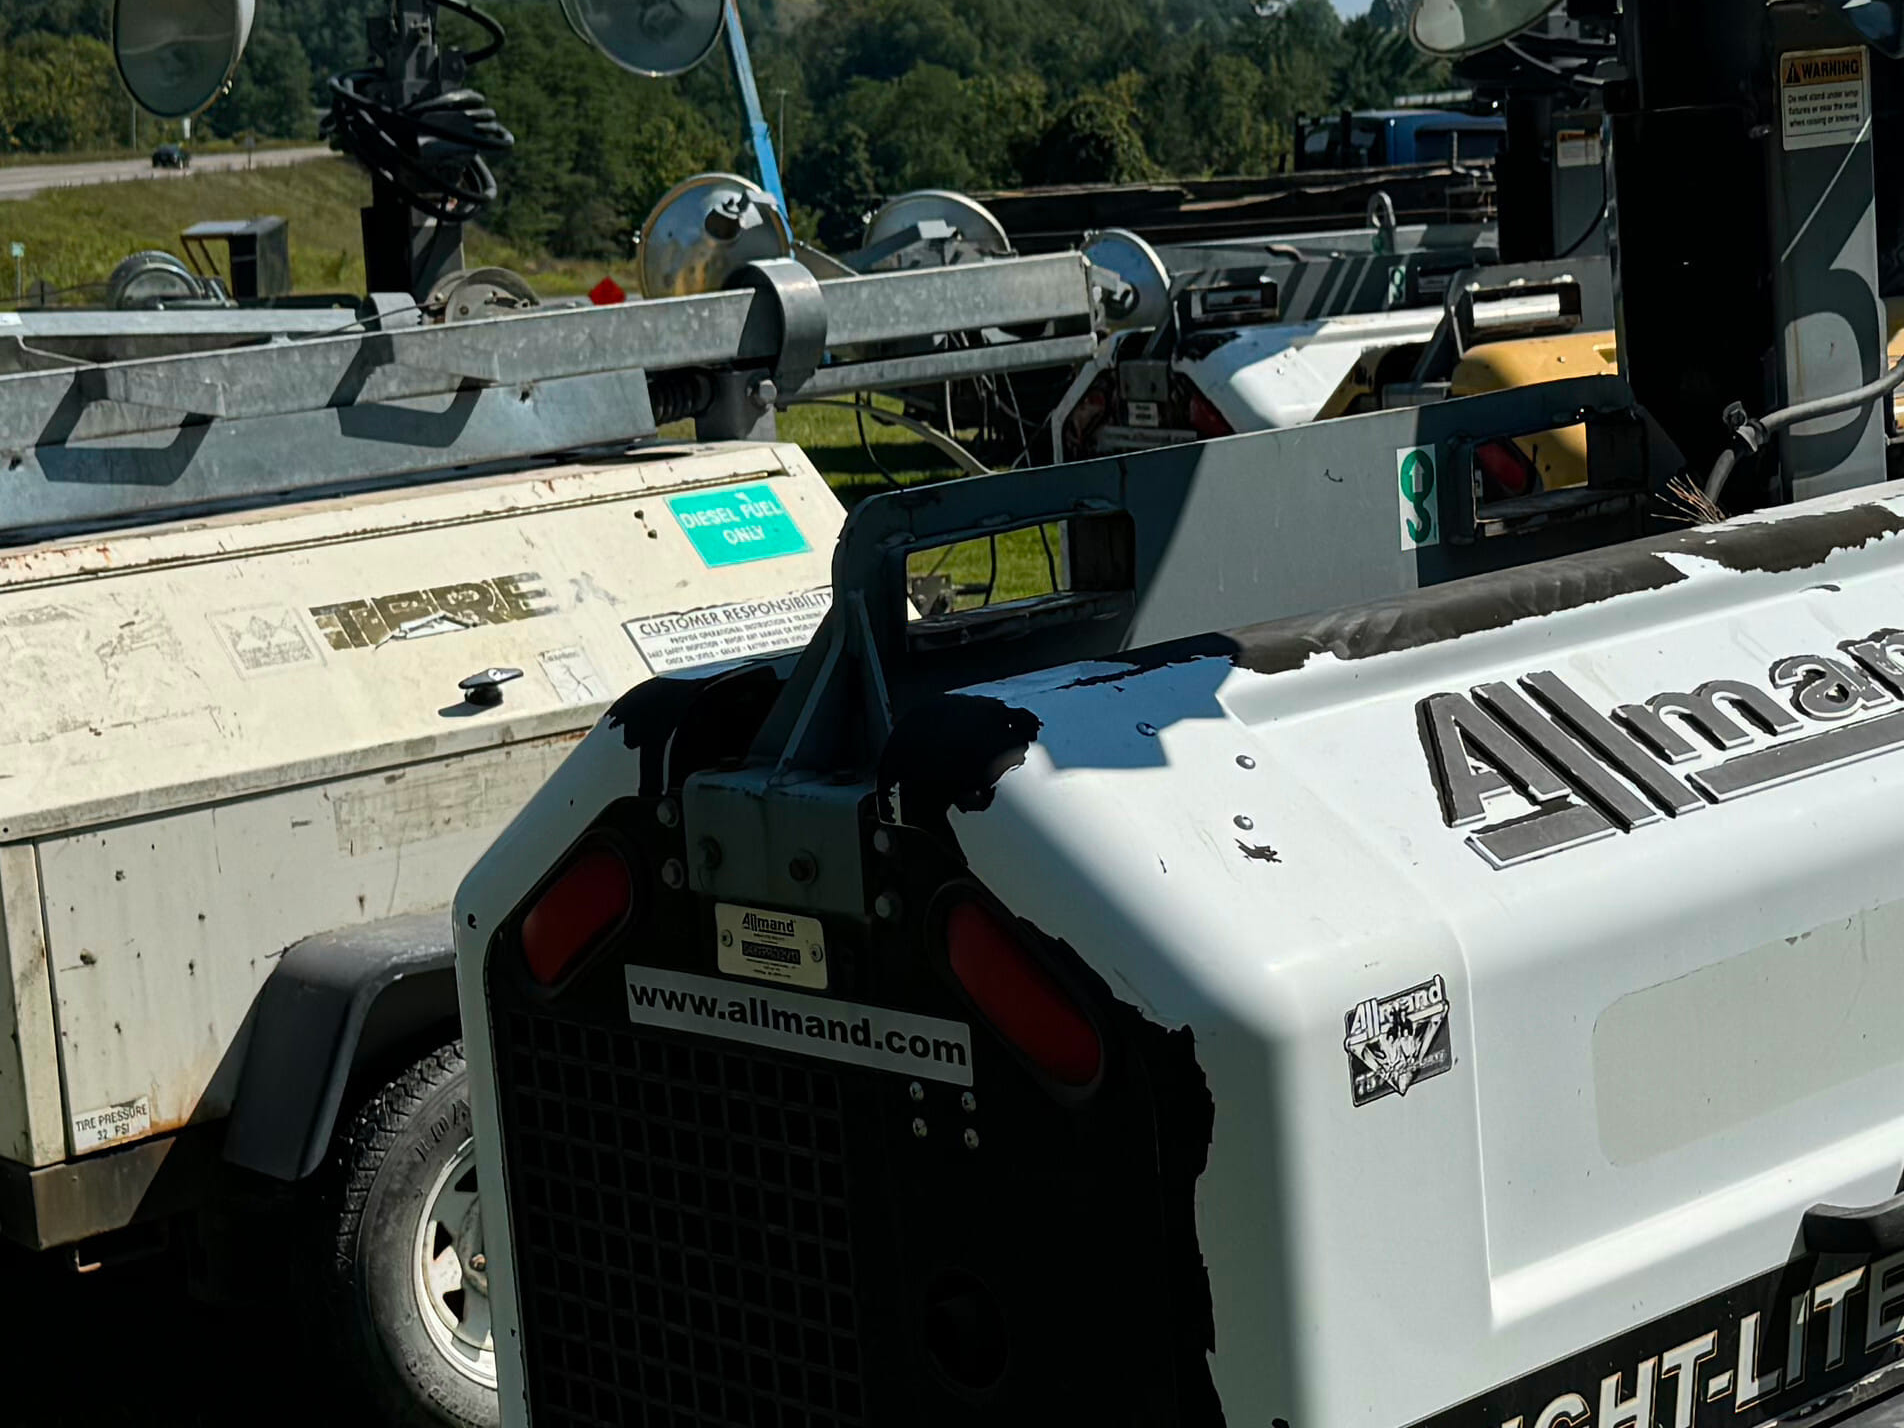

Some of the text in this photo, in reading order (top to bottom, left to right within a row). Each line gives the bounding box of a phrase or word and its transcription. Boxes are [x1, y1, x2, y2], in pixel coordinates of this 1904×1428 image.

[1802, 59, 1860, 79] WARNING
[679, 499, 784, 529] DIESEL FUEL
[723, 525, 766, 546] ONLY
[639, 610, 720, 637] CUSTOMER
[742, 913, 794, 934] Allmand
[1351, 974, 1443, 1038] Allmand
[629, 982, 967, 1067] www.allmand.com
[76, 1103, 147, 1132] TIRE PRESSURE
[114, 1123, 130, 1136] PSI
